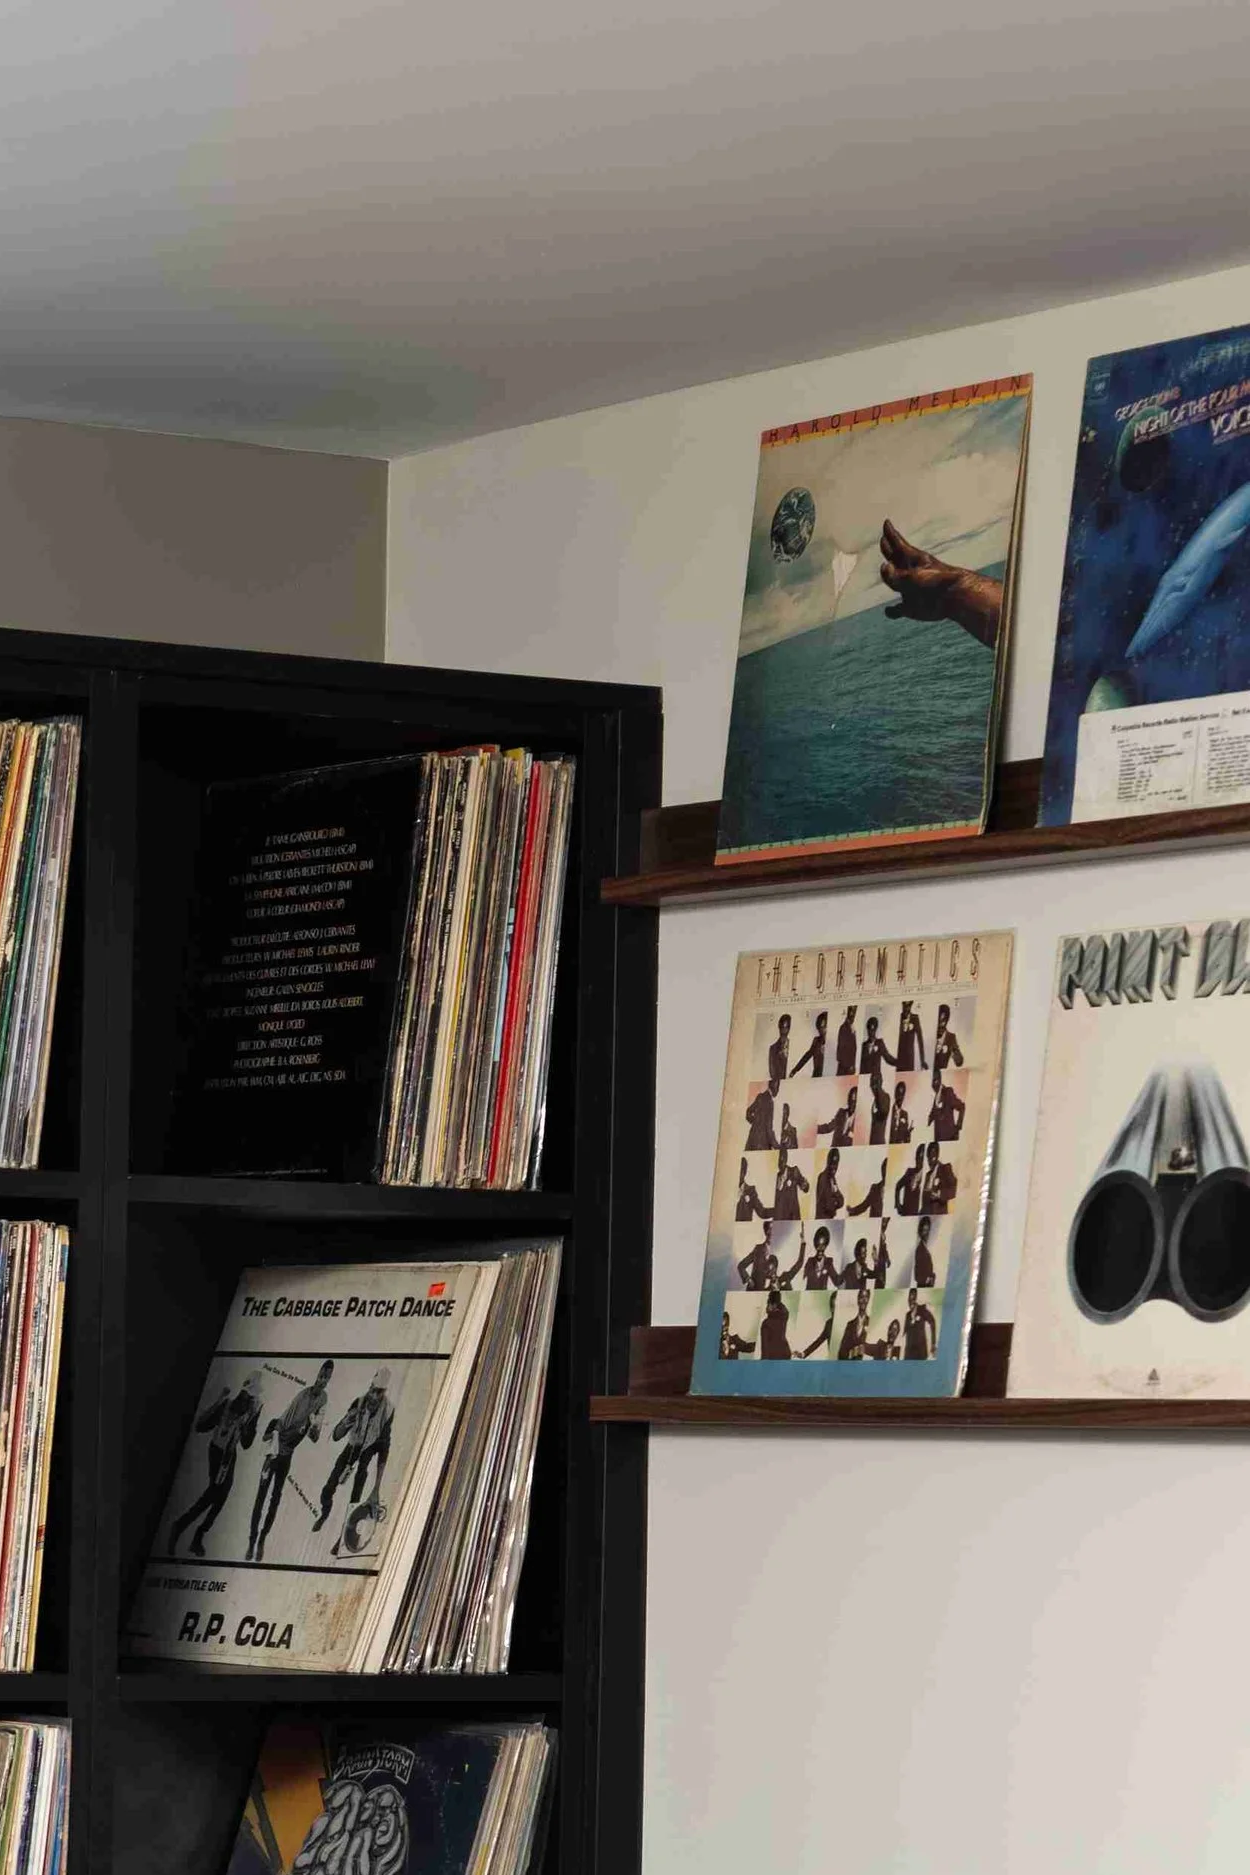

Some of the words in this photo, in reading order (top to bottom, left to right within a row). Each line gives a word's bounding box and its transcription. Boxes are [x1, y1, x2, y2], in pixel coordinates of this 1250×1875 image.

[768, 405, 882, 442] HAROLD
[909, 374, 1022, 412] MELVIN
[756, 954, 801, 998] THE
[815, 938, 982, 994] DRAMATICS
[1058, 926, 1190, 1010] POINT
[241, 1297, 271, 1317] THE
[273, 1297, 343, 1318] CABBAGE
[345, 1297, 397, 1318] PATCH
[399, 1297, 456, 1318] DANCE
[208, 1580, 228, 1592] ONE
[178, 1611, 226, 1644] R.P.
[235, 1615, 294, 1649] COLA
